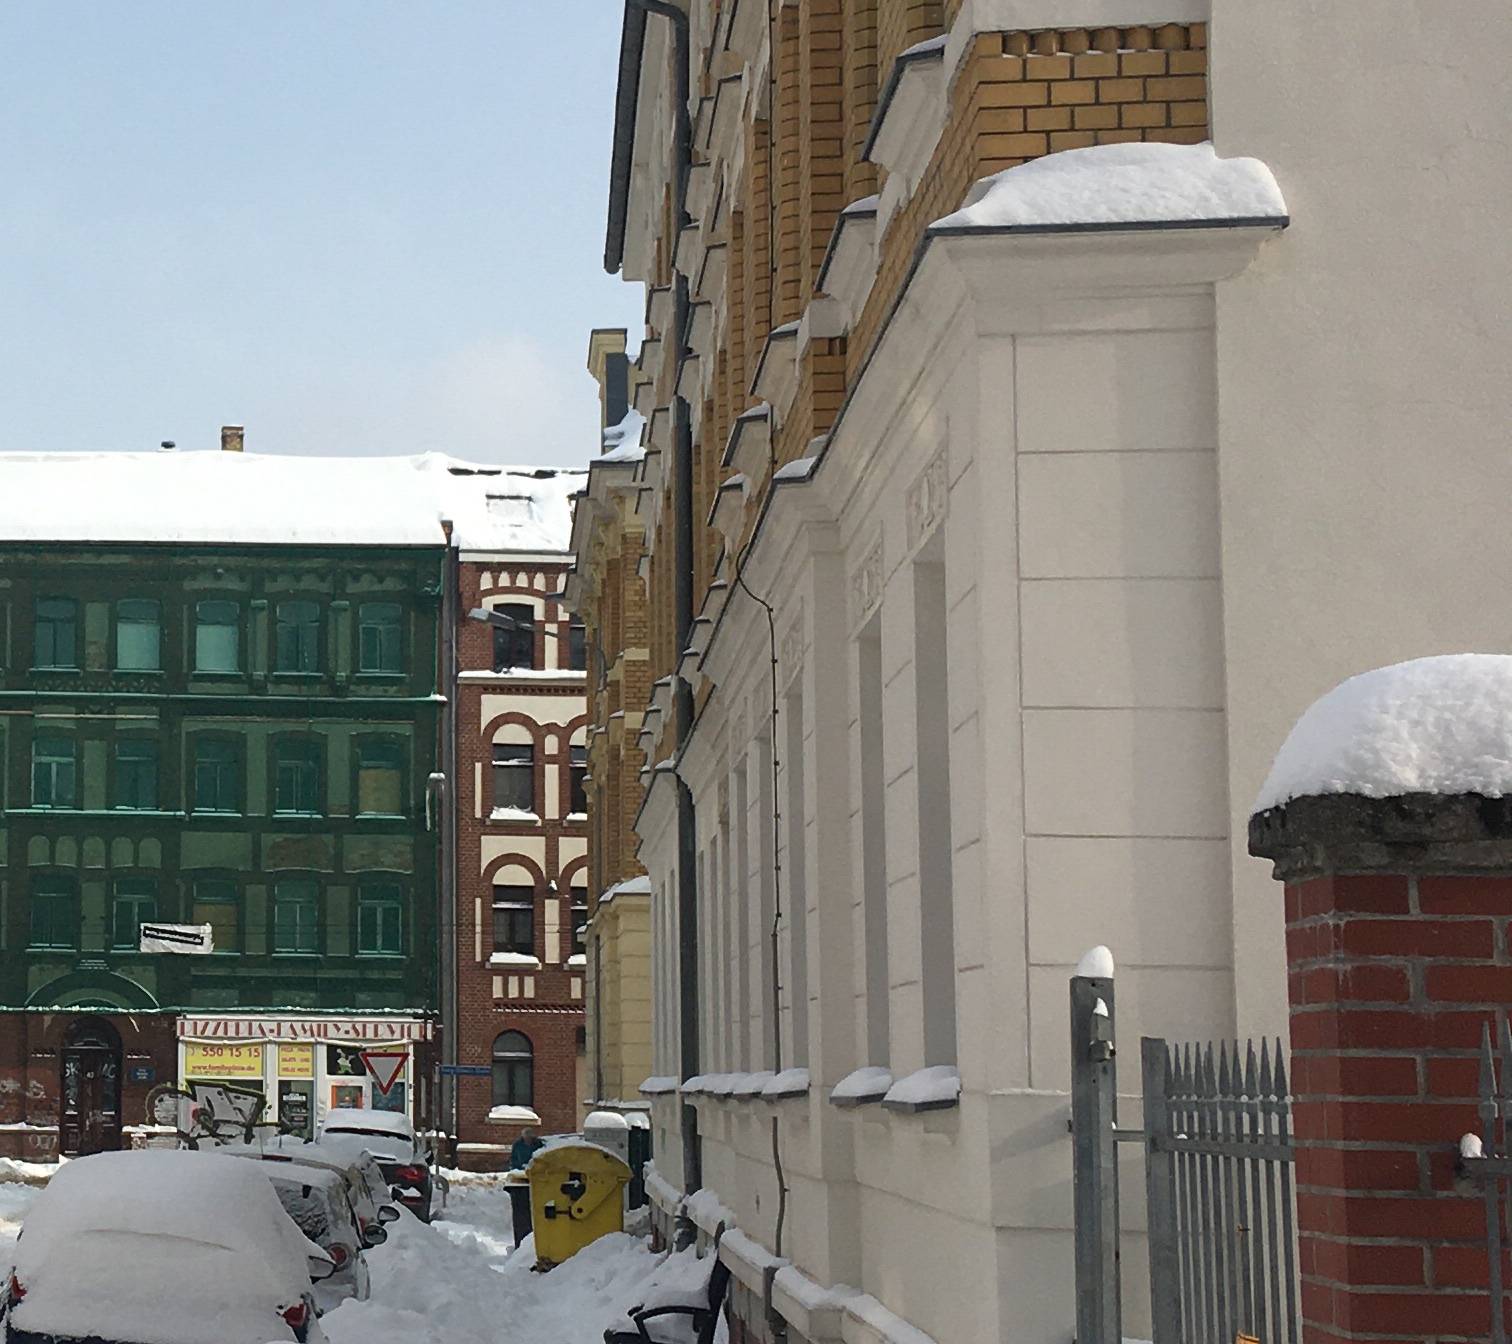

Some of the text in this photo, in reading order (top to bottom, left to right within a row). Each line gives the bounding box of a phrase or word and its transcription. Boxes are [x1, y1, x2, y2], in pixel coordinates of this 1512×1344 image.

[202, 1047, 260, 1058] 550 15 15
